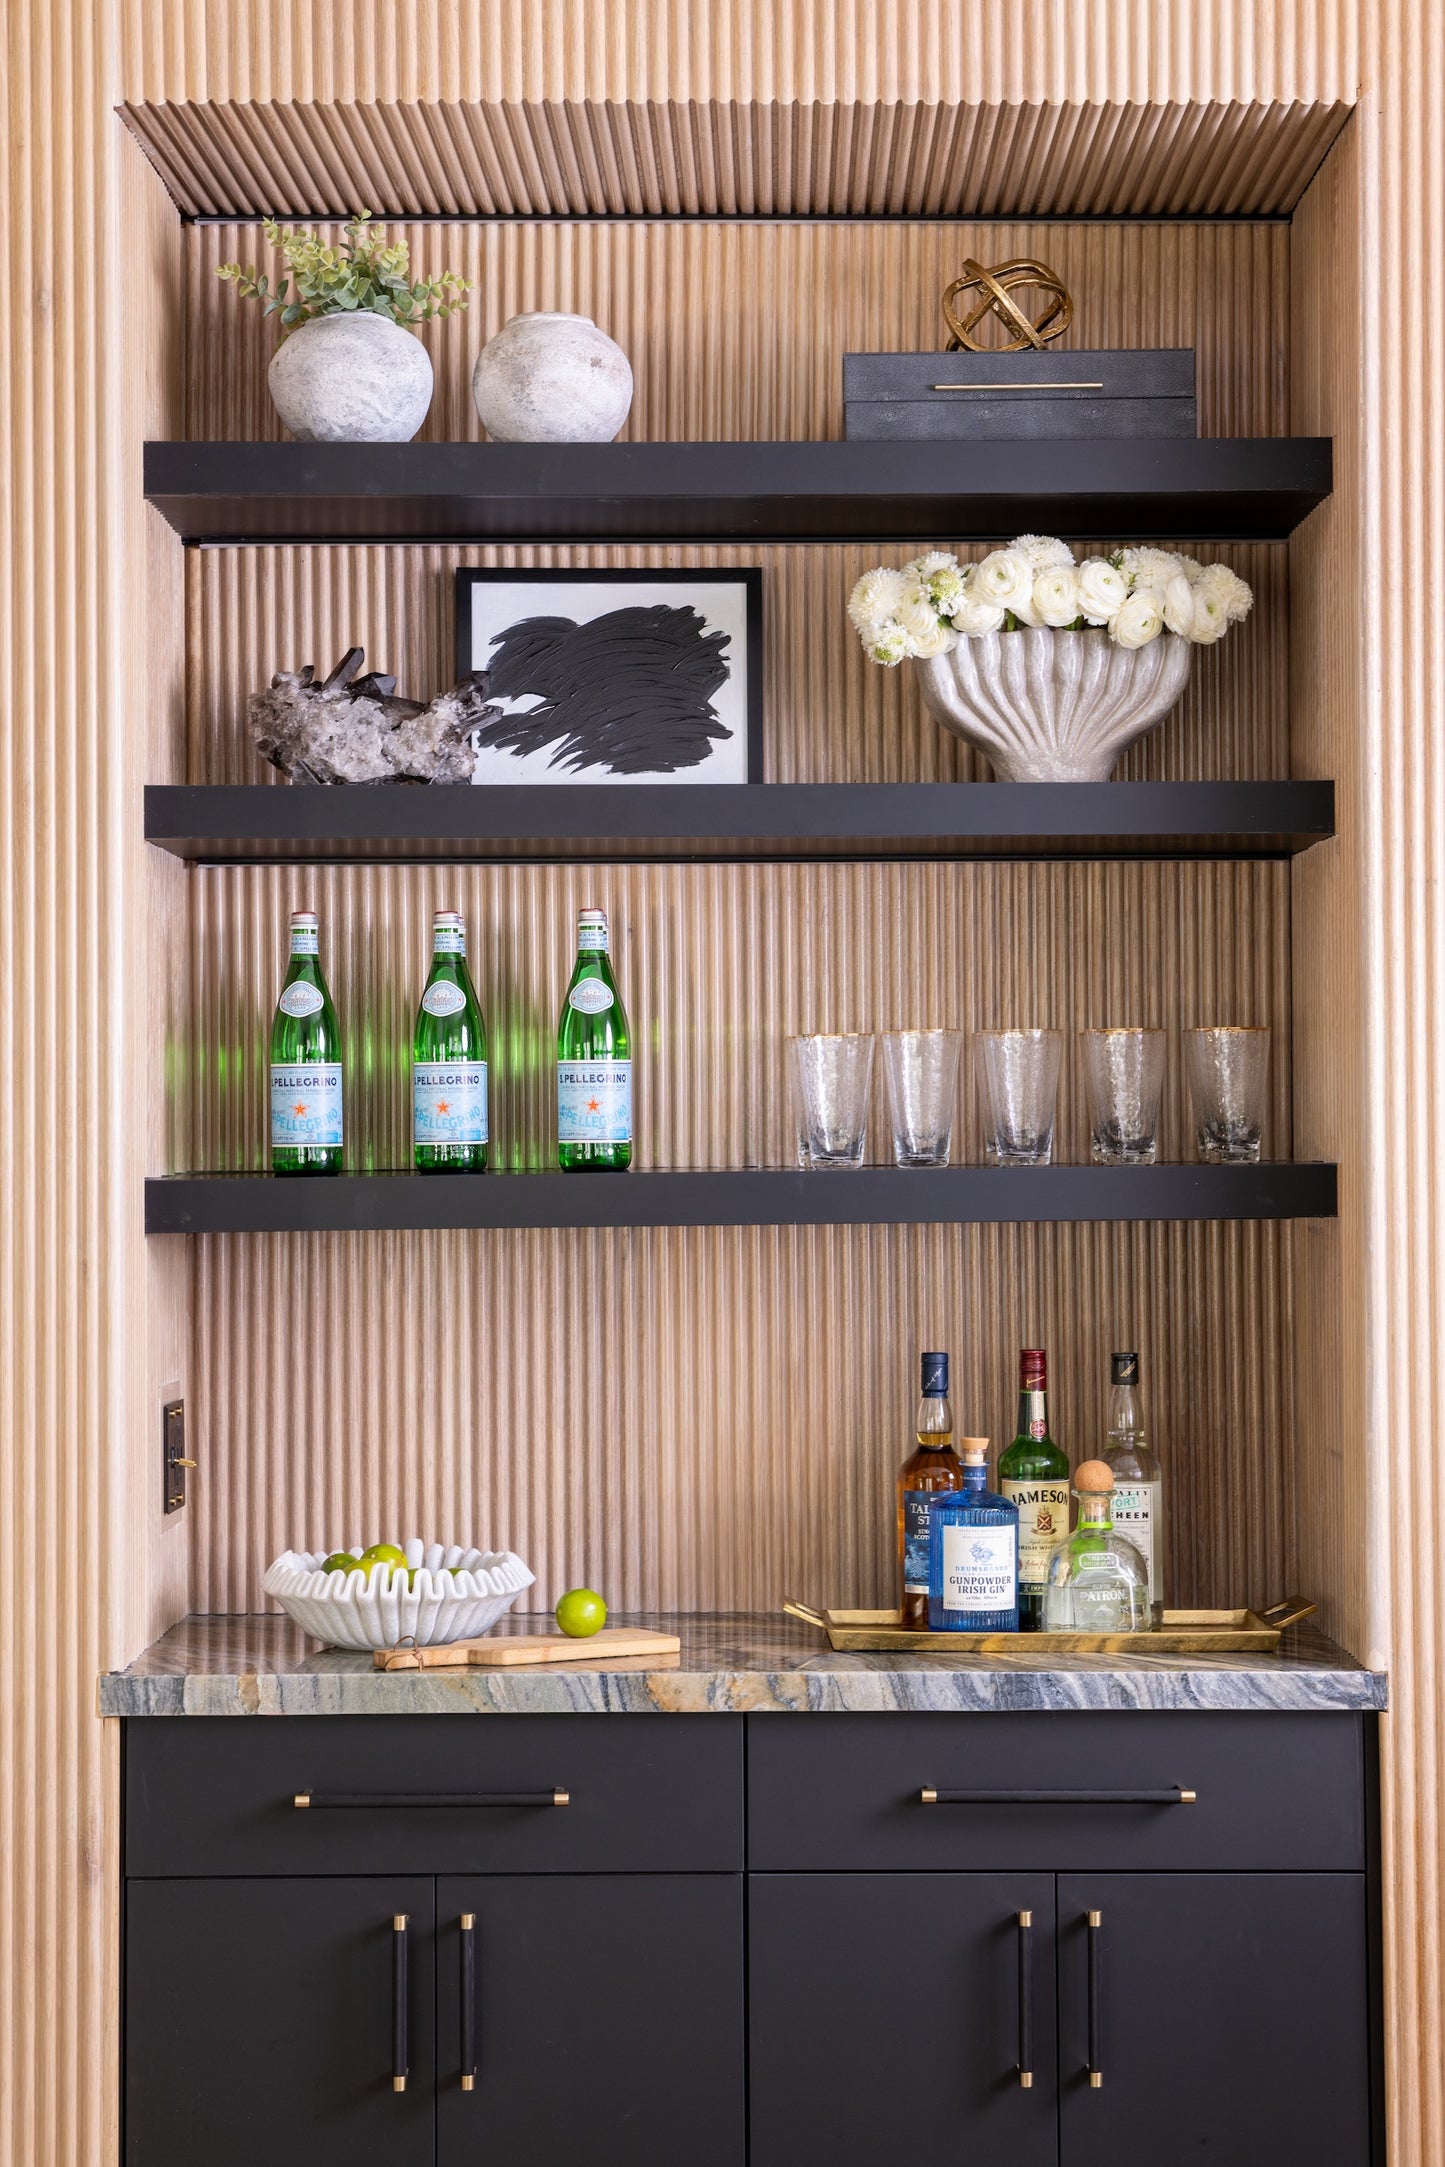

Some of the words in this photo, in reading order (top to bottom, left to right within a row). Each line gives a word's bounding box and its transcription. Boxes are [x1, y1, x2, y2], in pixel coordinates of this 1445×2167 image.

[1012, 1489, 1067, 1506] JAMESON
[1112, 1496, 1137, 1508] ORT
[949, 1576, 1011, 1585] GUNPOWDER
[958, 1586, 986, 1594] IRISH
[989, 1585, 1005, 1594] GIN
